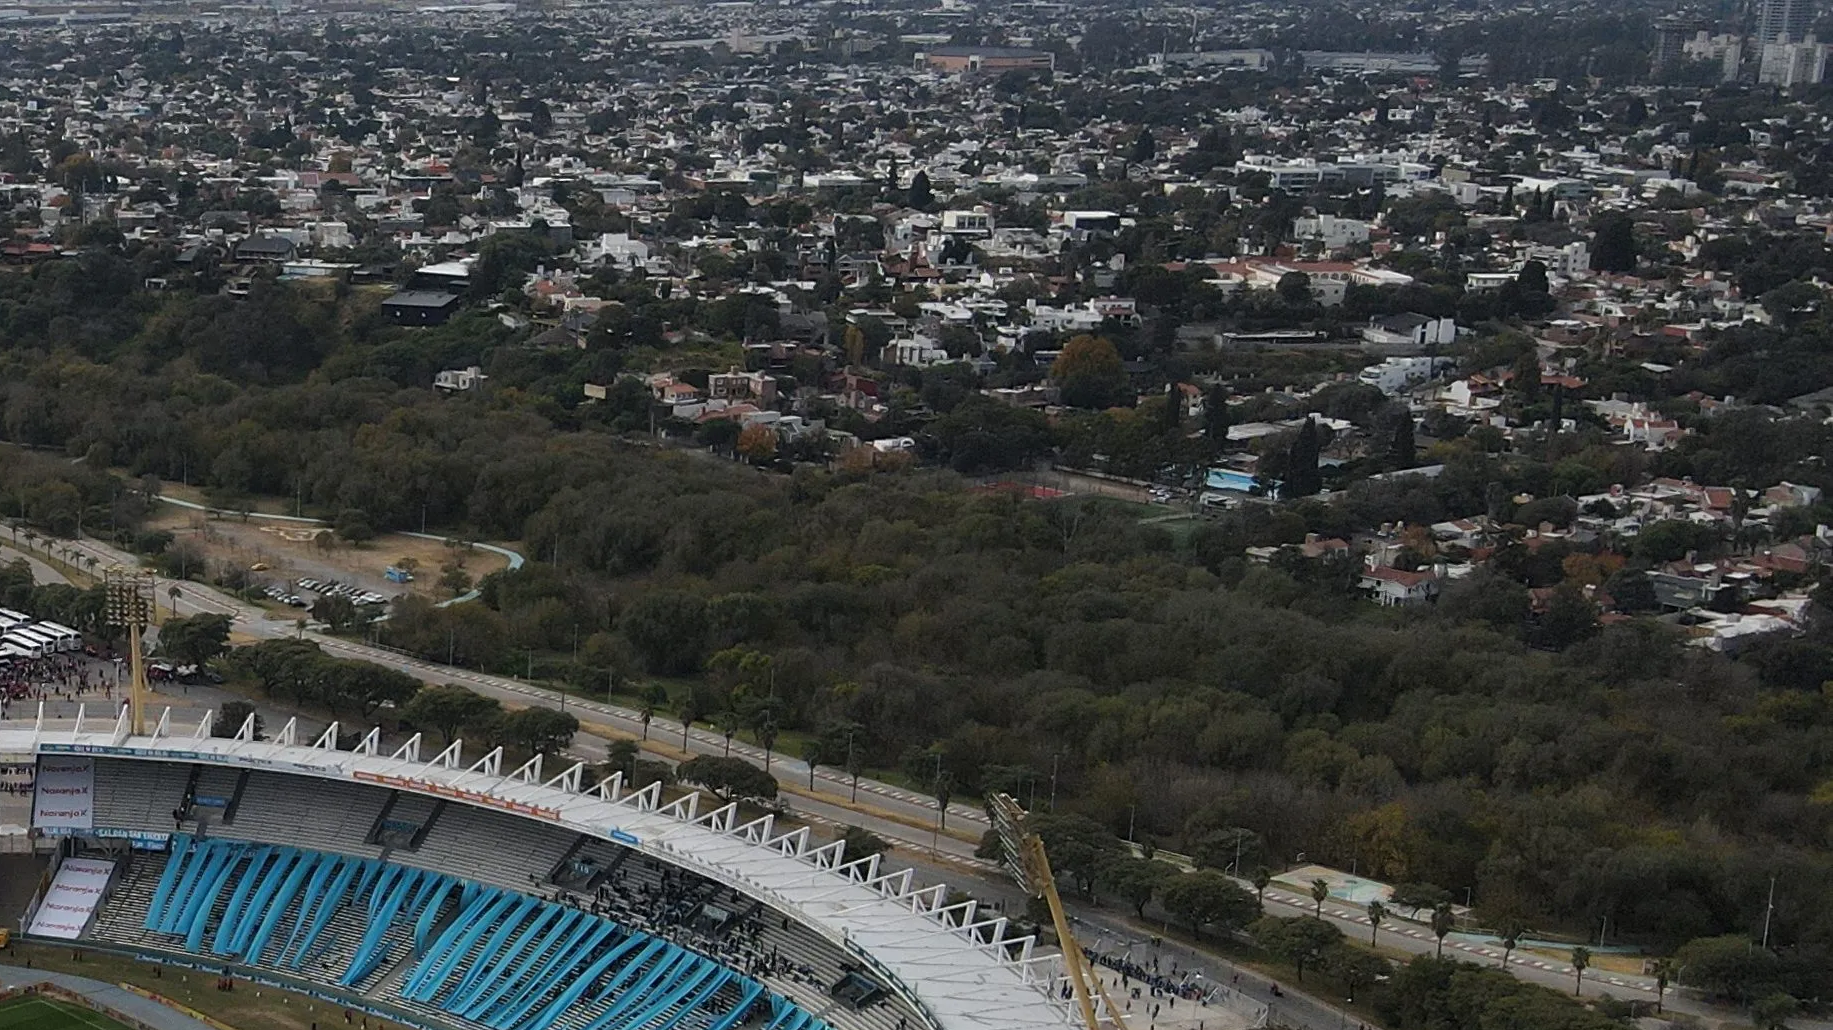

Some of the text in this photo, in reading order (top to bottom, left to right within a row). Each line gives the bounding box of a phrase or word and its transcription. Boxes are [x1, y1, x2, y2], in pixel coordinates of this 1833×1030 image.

[42, 764, 82, 774] Naranja
[41, 786, 80, 796] Naranja
[40, 809, 80, 819] Naranja
[55, 883, 93, 895] Naranja
